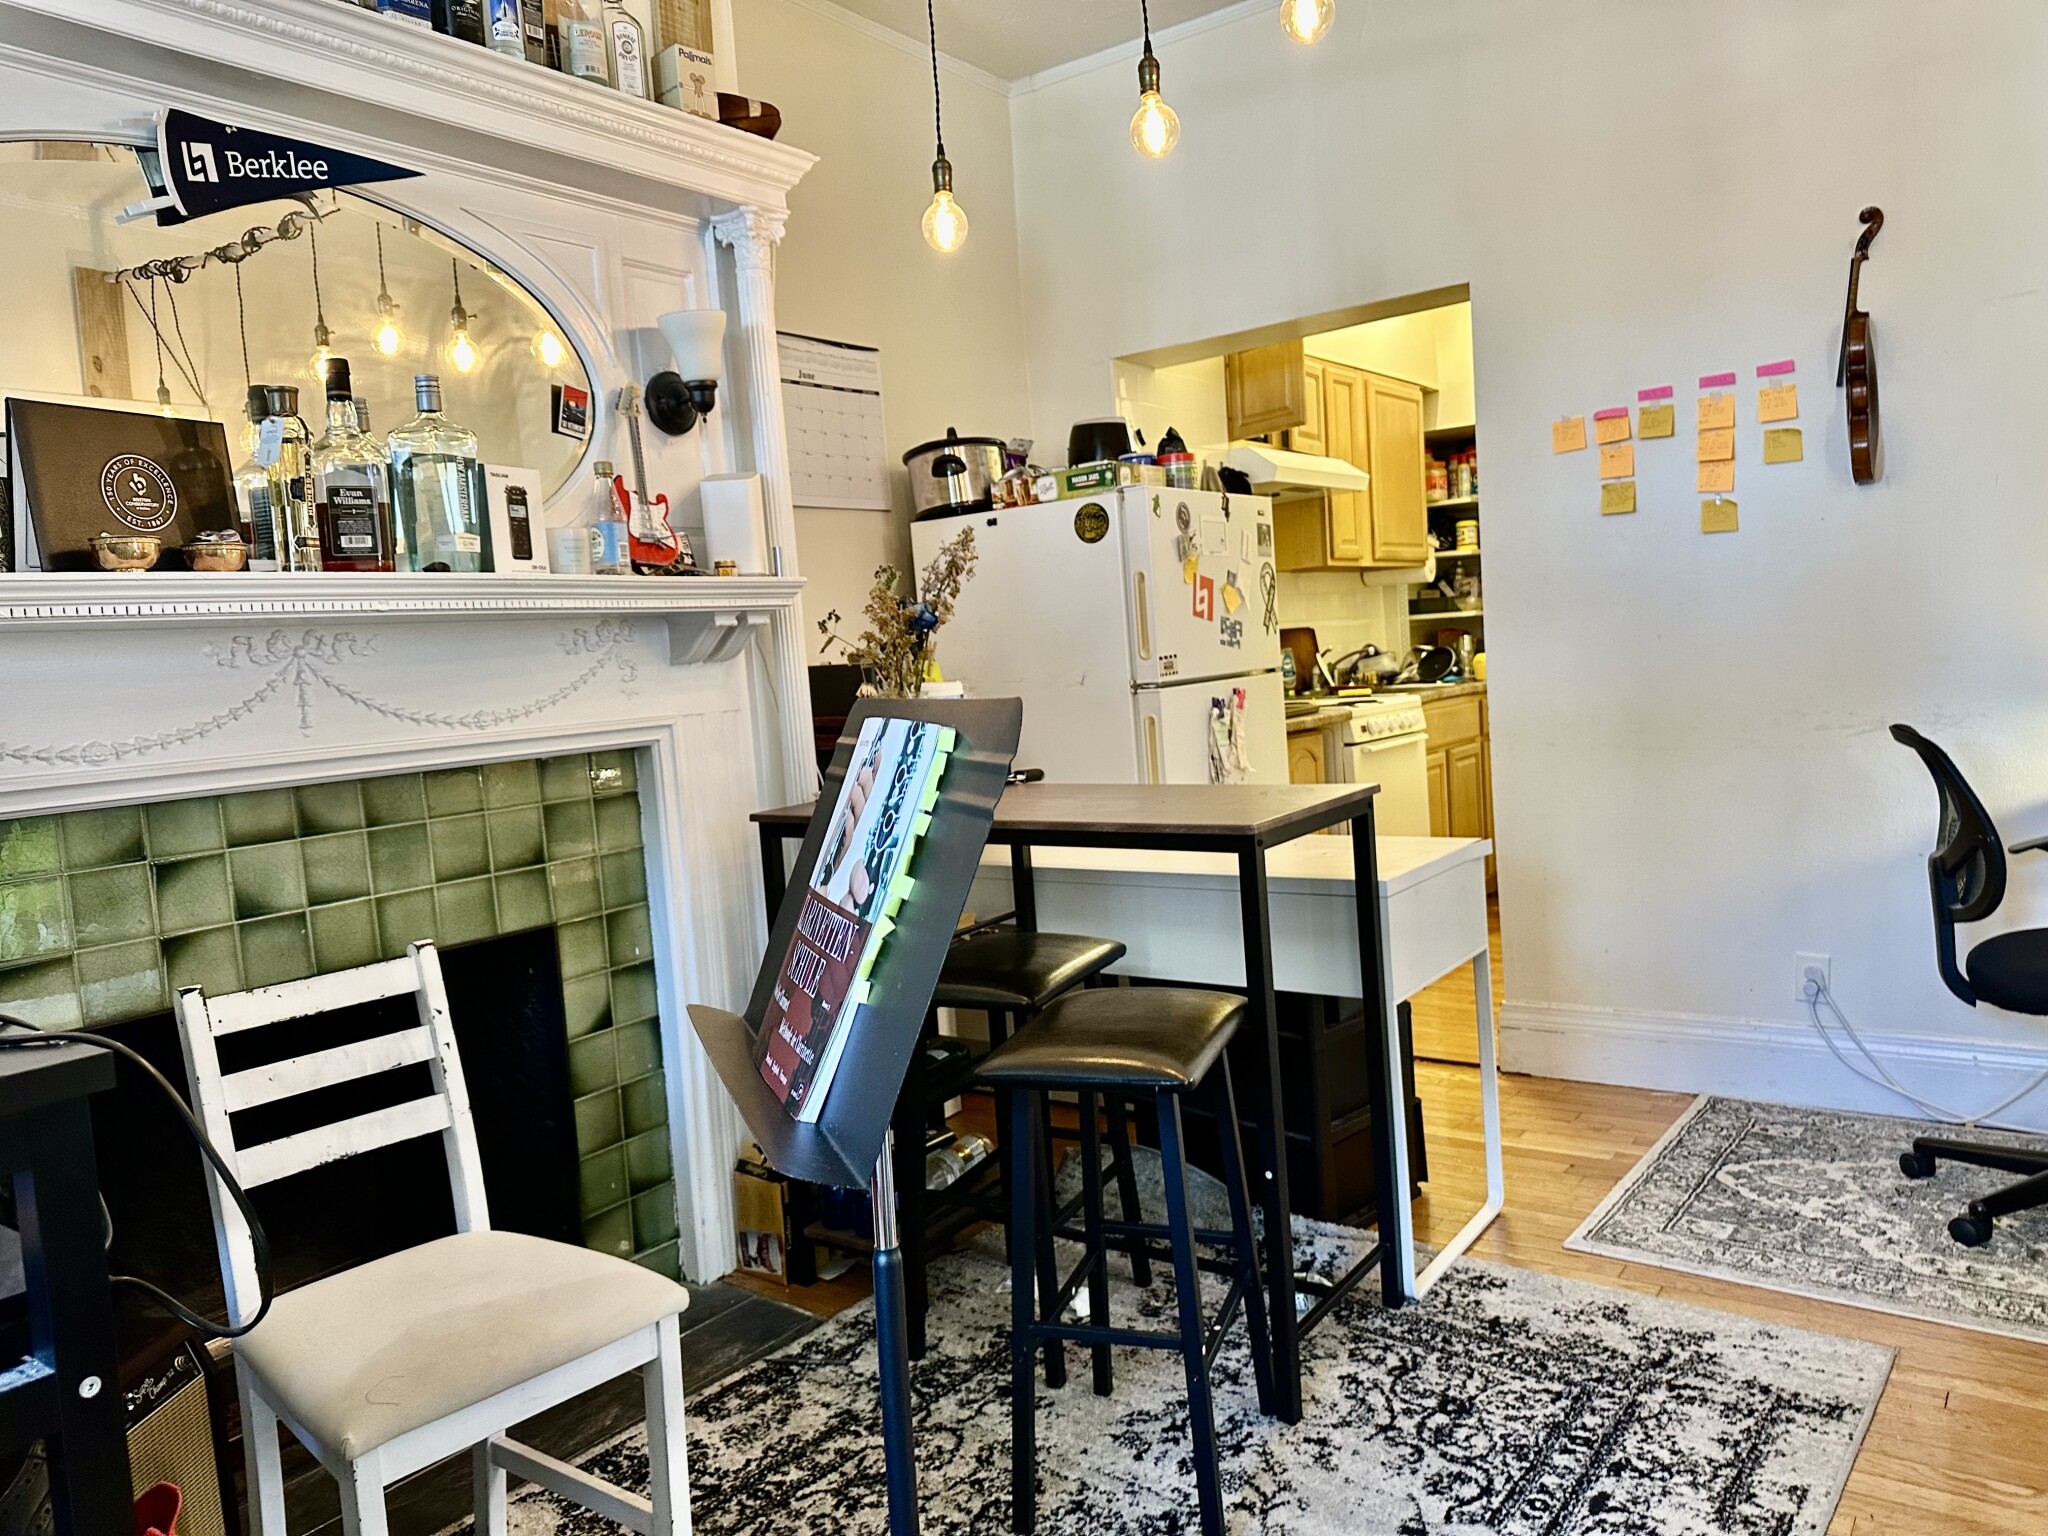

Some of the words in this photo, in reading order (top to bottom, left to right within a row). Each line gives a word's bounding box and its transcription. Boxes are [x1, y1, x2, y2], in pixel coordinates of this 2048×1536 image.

[224, 150, 329, 180] Berklee
[798, 370, 816, 380] June
[105, 461, 122, 483] YEARS
[123, 458, 135, 466] OF
[138, 459, 174, 505] EXCELLENCE
[1071, 474, 1088, 484] MASON
[1087, 472, 1100, 481] JARS
[339, 488, 364, 497] Evan
[333, 496, 373, 505] Williams
[126, 515, 145, 528] EST.
[147, 516, 164, 528] 1867
[787, 940, 827, 999] SCHULE
